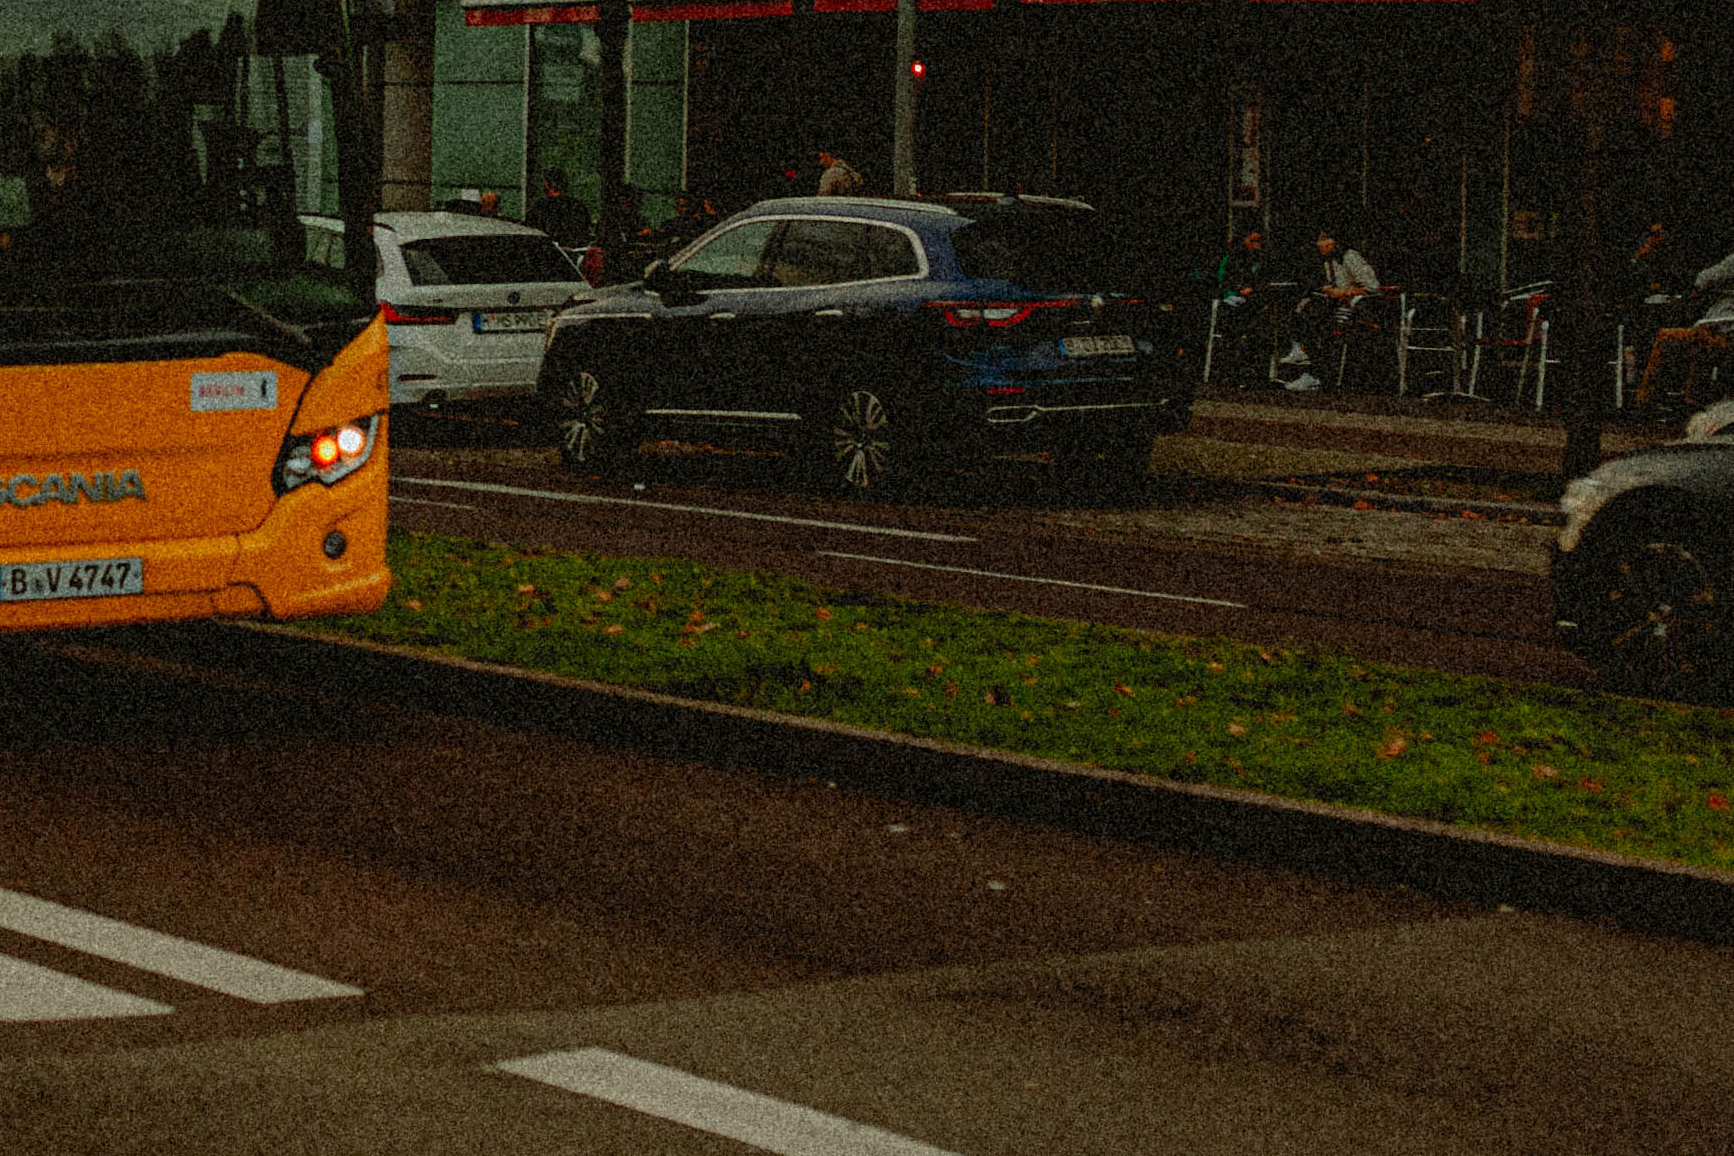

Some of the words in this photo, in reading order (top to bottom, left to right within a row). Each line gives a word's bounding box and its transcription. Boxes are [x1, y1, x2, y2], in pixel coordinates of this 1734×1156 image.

[11, 568, 27, 595] B
[45, 565, 62, 593] V
[69, 562, 131, 591] 4747
